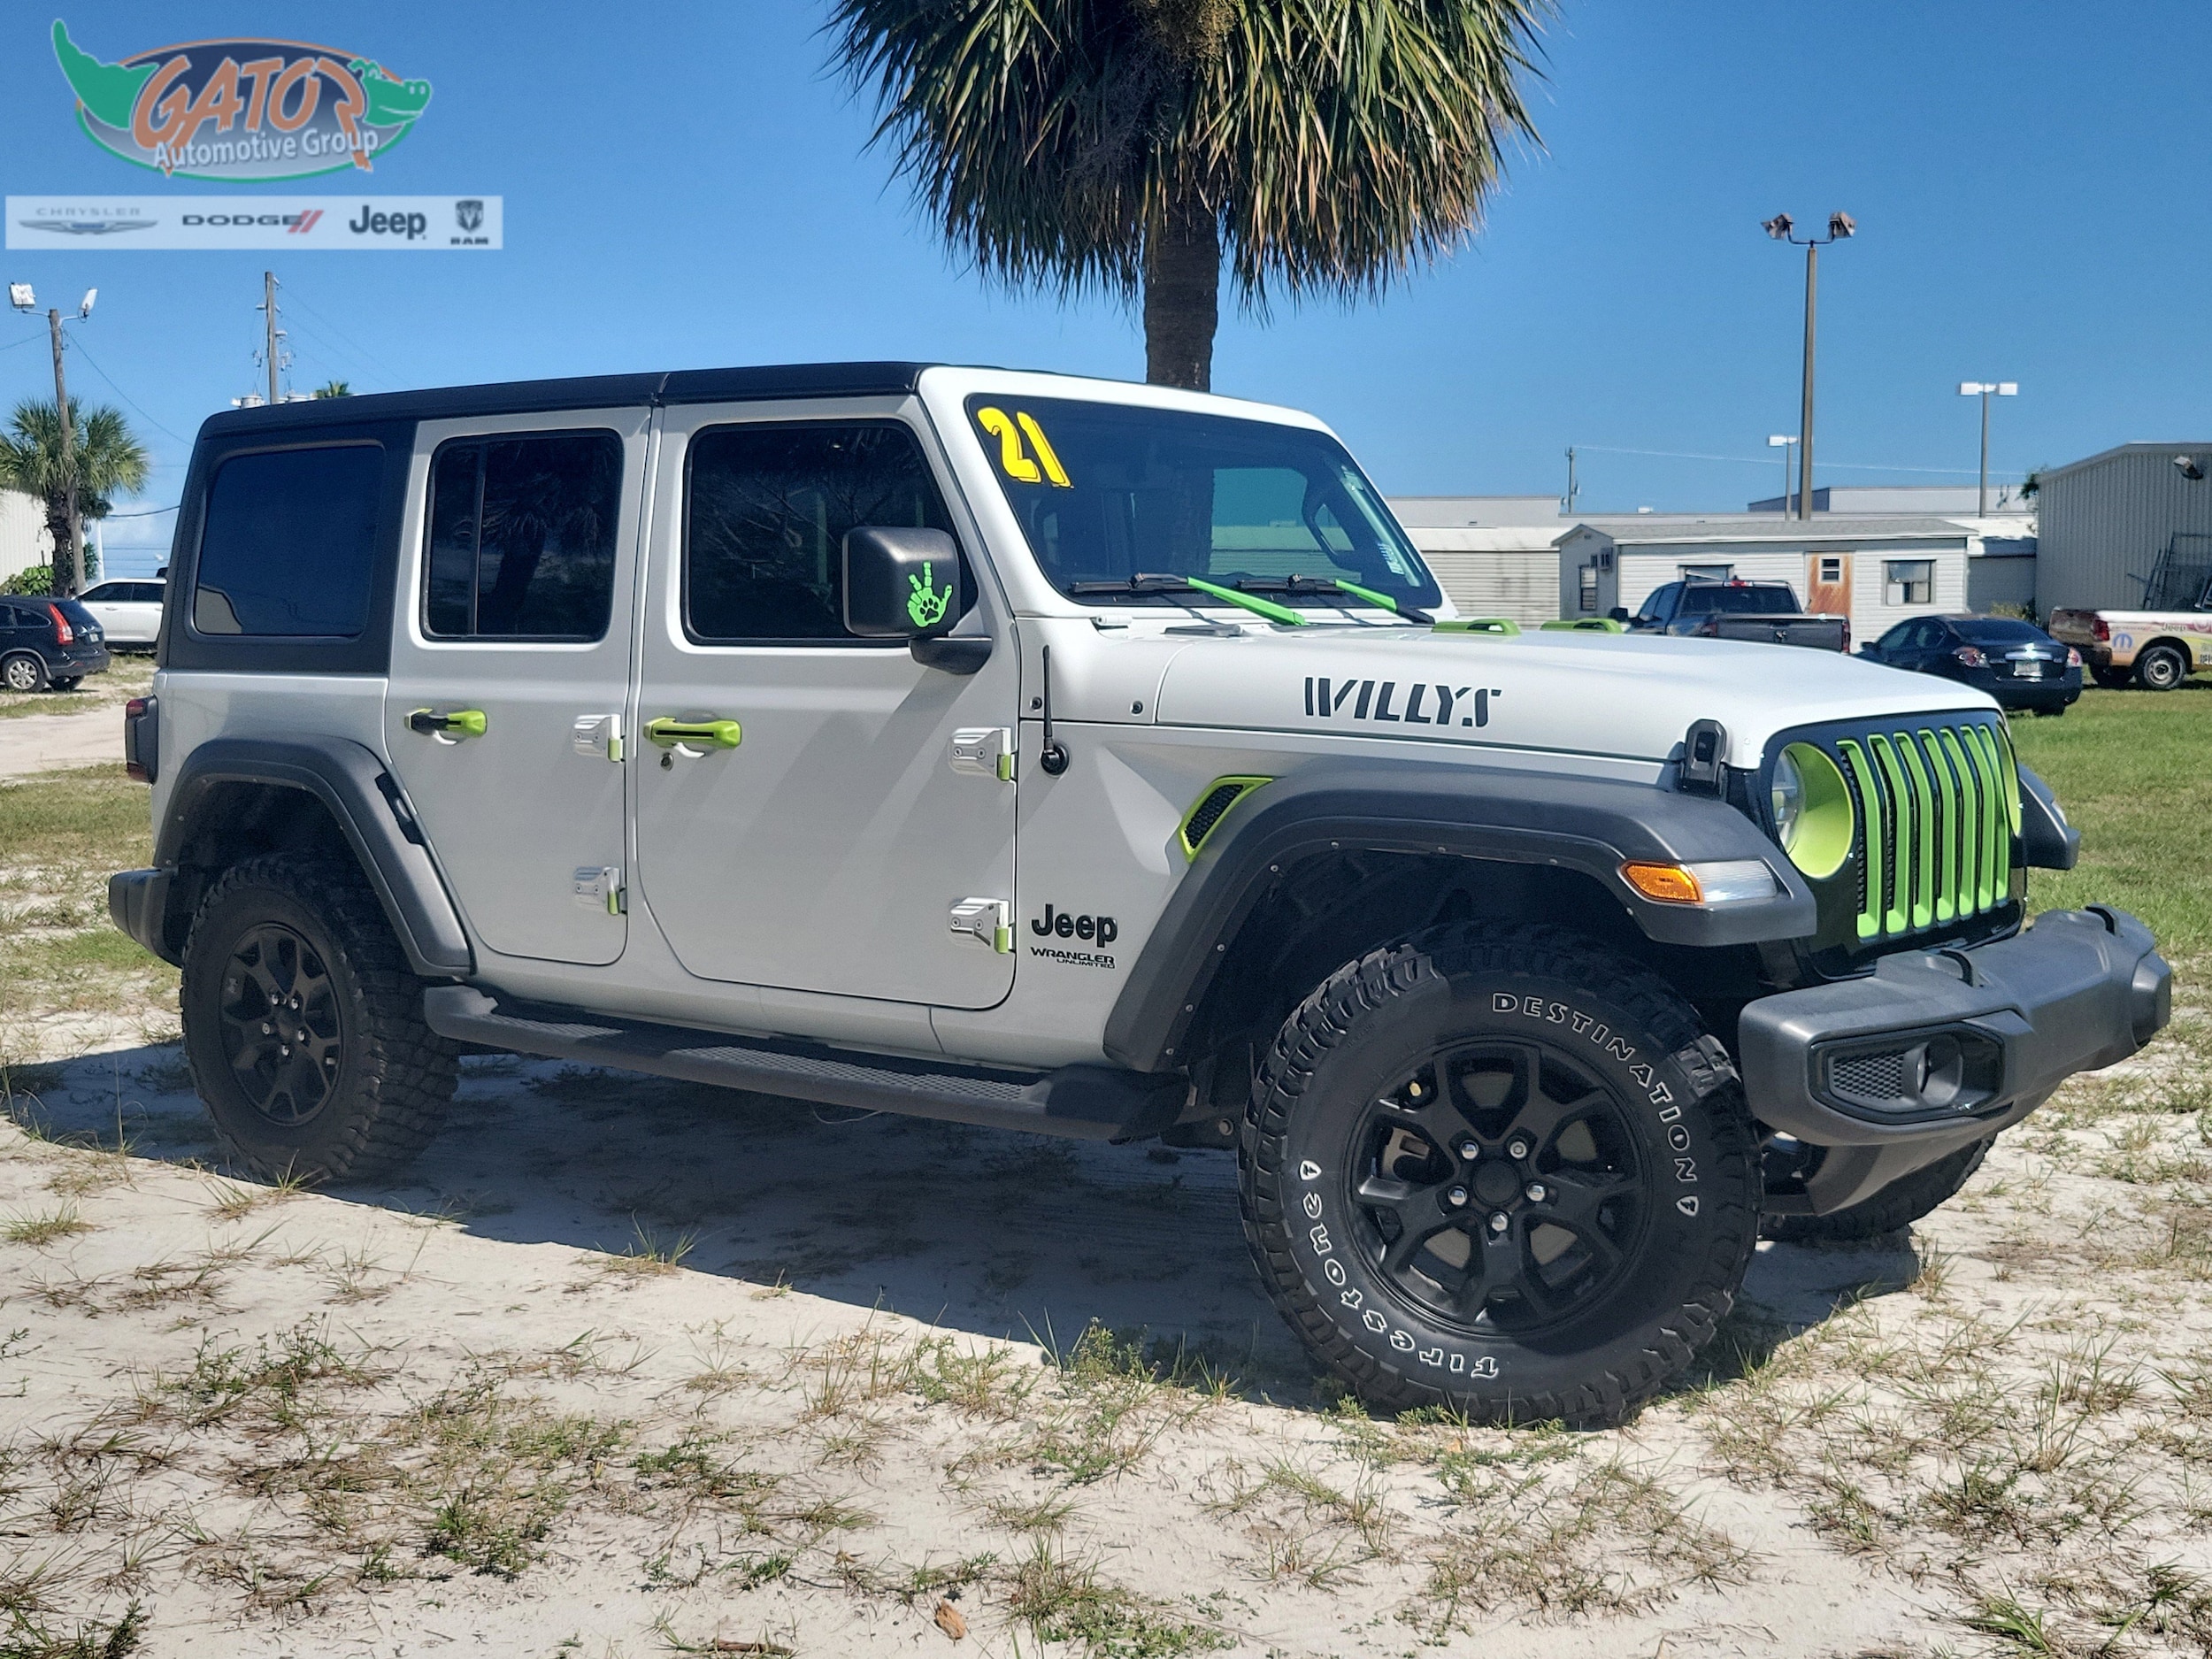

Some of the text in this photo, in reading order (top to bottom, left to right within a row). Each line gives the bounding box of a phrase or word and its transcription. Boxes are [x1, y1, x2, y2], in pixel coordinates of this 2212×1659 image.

[977, 407, 1071, 488] 21
[1304, 677, 1502, 727] WILLYS
[1031, 903, 1118, 948] Jeep
[1030, 946, 1115, 964] WRANGLER
[1056, 957, 1116, 970] UNLIMITED
[1493, 993, 1697, 1182] DESTINATION
[1302, 1191, 1499, 1379] Firestone
